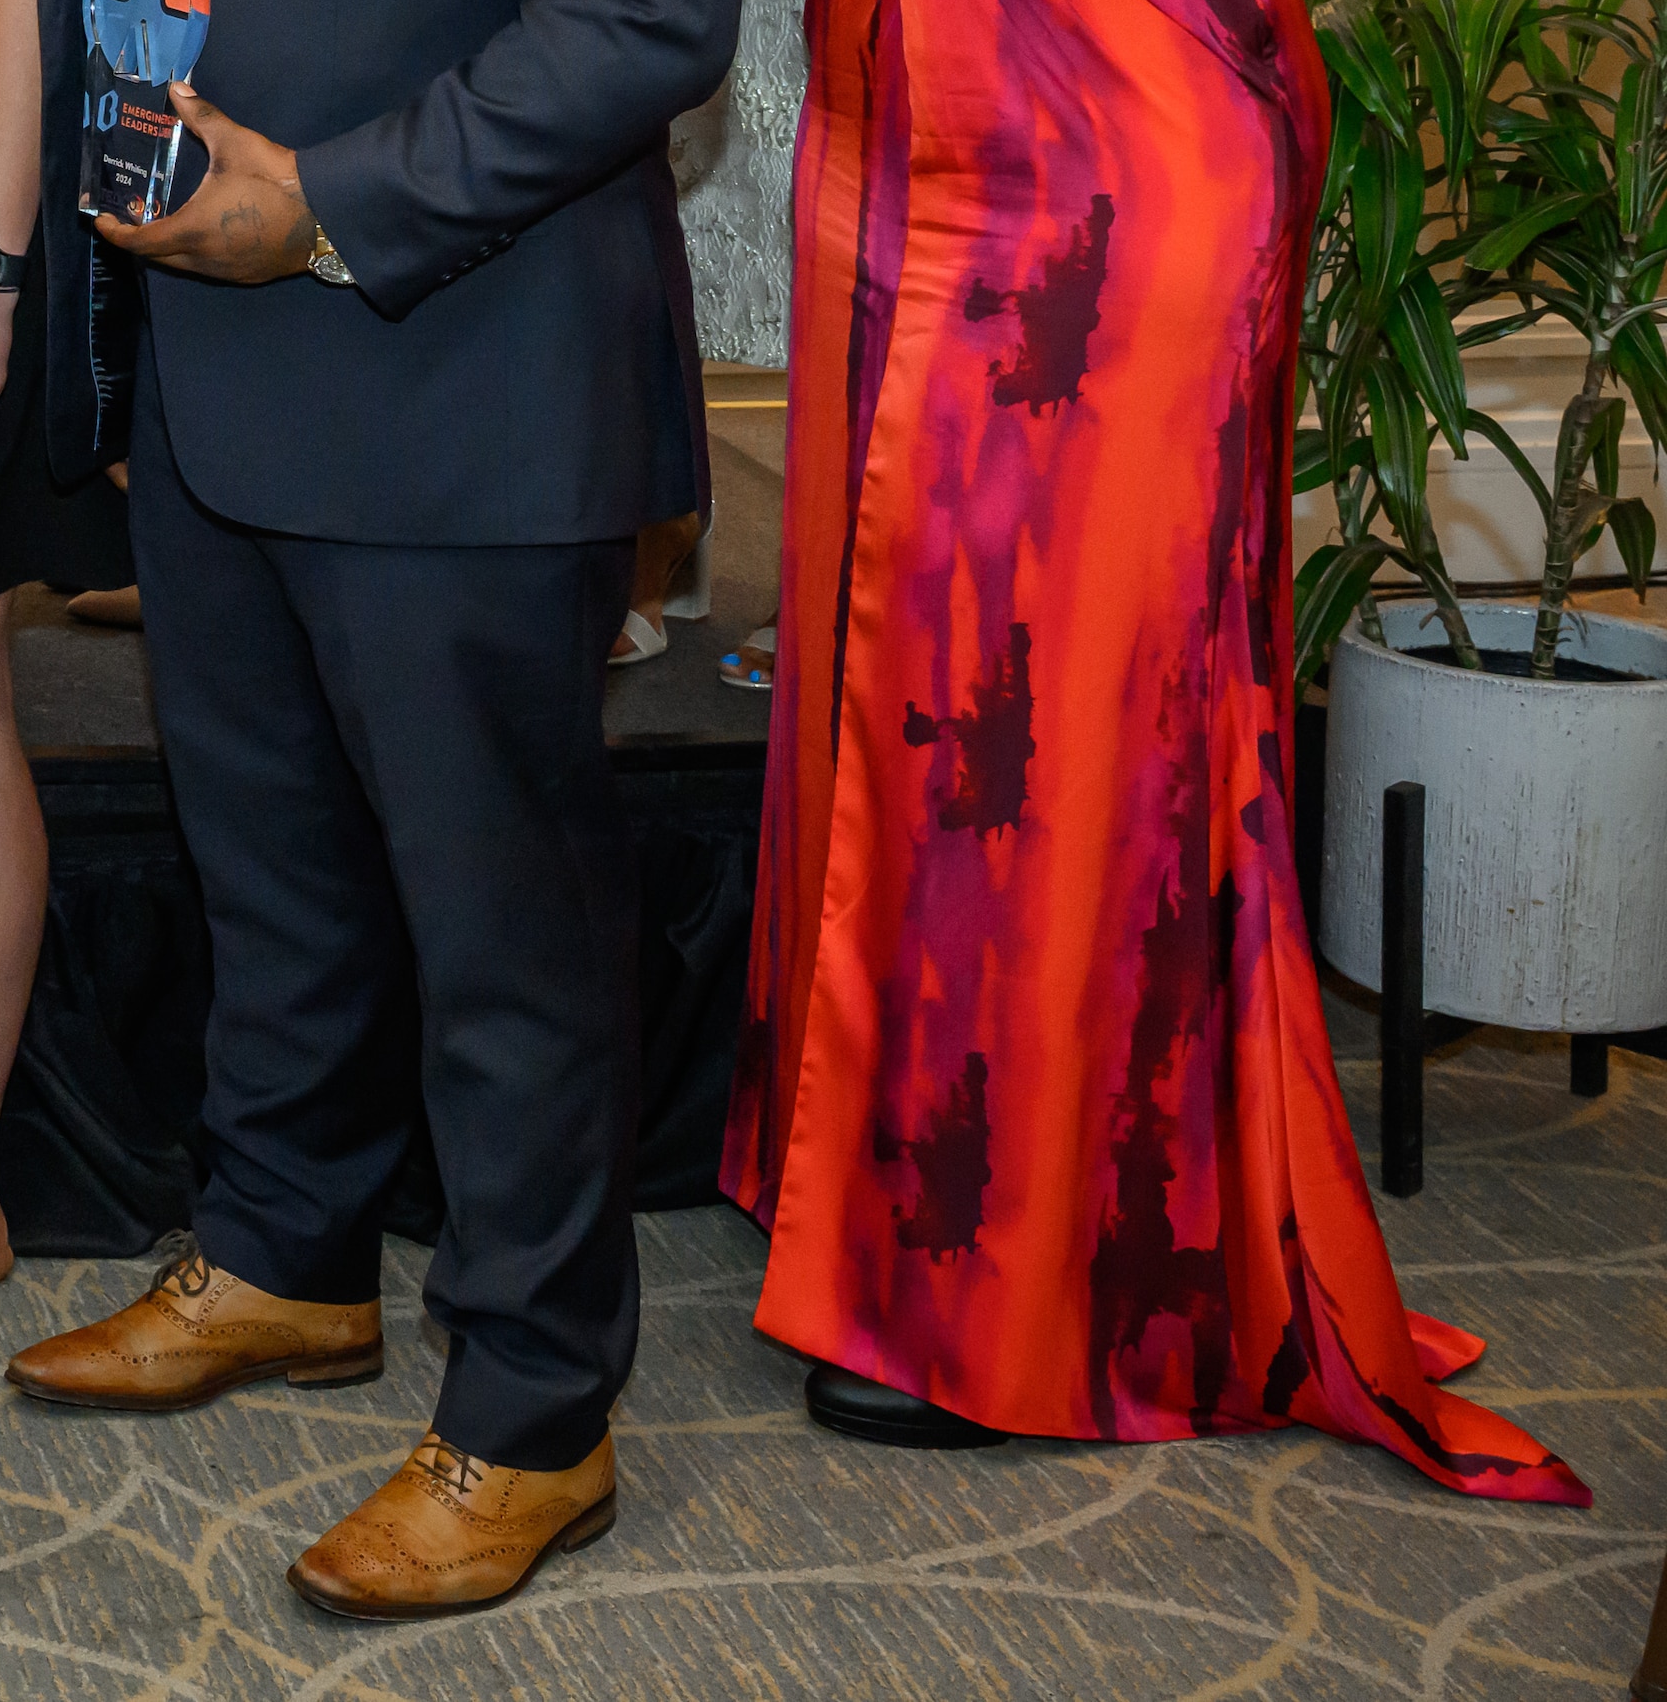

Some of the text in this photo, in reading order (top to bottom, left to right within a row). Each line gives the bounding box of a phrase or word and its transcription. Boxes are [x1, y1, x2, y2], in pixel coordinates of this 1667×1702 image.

[120, 116, 158, 137] LEADERS
[104, 154, 124, 169] Derrick
[125, 162, 147, 178] Whiting
[115, 173, 132, 186] 2024
